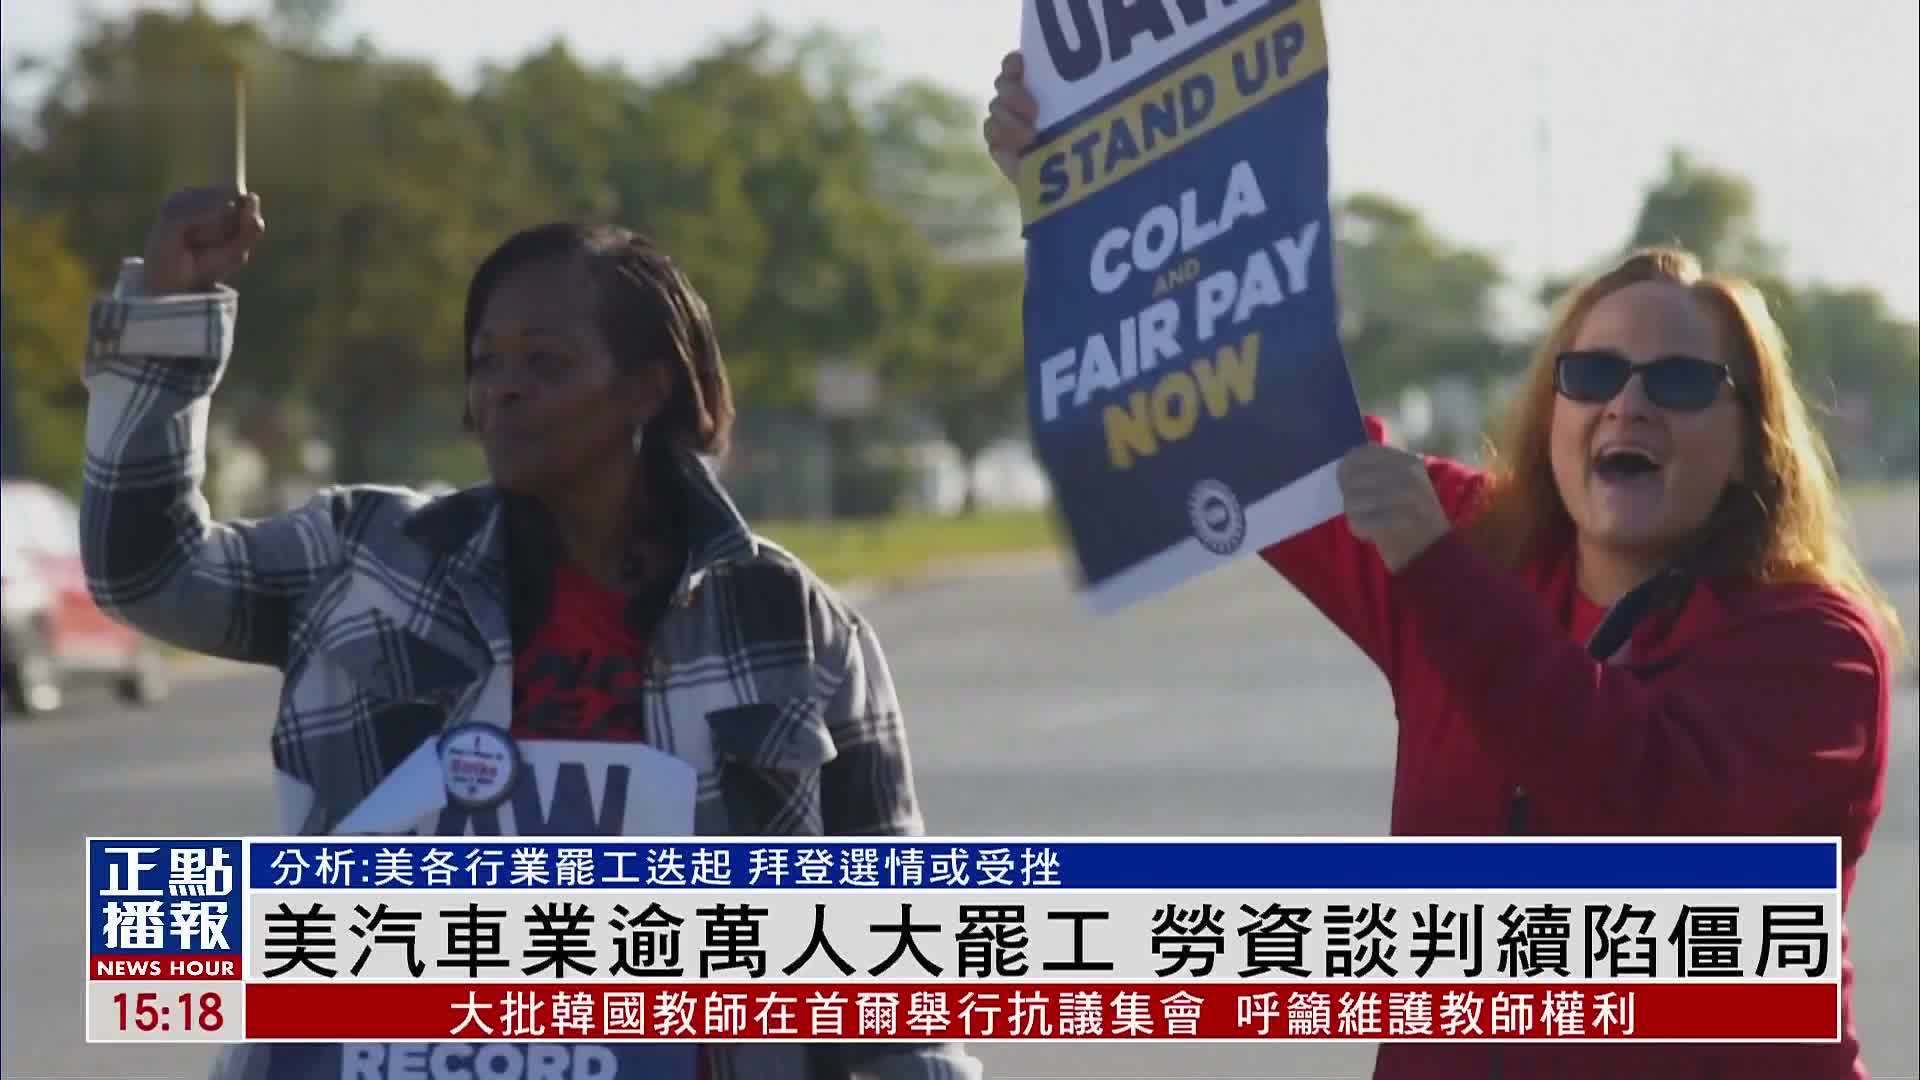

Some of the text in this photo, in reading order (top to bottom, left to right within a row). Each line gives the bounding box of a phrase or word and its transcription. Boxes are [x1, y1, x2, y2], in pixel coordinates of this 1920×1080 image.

[1035, 0, 1236, 82] UA
[1039, 22, 1305, 206] STAND UP
[1090, 159, 1267, 294] COLA
[1153, 257, 1201, 297] AND
[1040, 219, 1320, 422] FAIR PAY
[1103, 333, 1261, 469] NOW
[341, 1043, 618, 1080] RECORD
